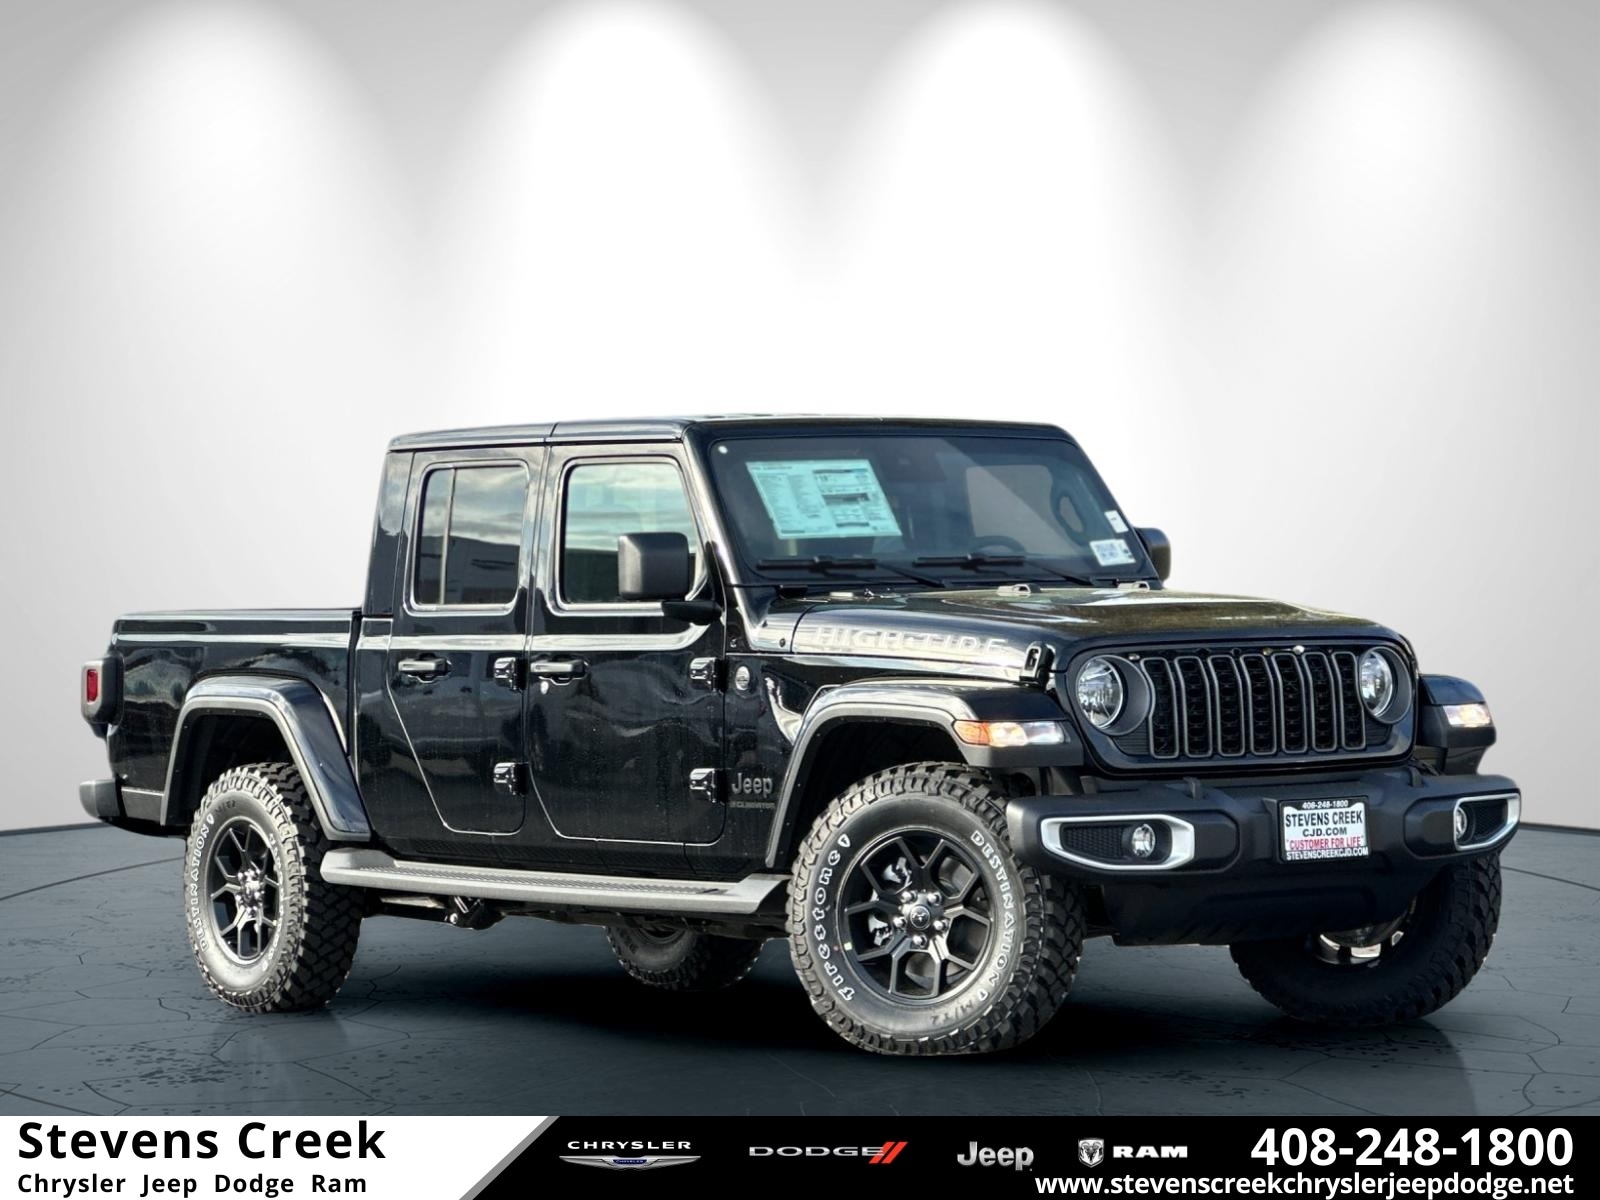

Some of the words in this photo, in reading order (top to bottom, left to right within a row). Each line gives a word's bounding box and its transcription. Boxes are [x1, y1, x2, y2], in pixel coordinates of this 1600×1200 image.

[731, 772, 772, 798] Jeep
[1285, 812, 1330, 828] STEVENS
[1332, 810, 1363, 825] CREEK
[1302, 827, 1348, 837] CJD.COM
[1331, 837, 1345, 848] FOR
[1286, 846, 1369, 860] STEVENSCREEKCJD.COM
[970, 830, 1017, 987] DESTINATION
